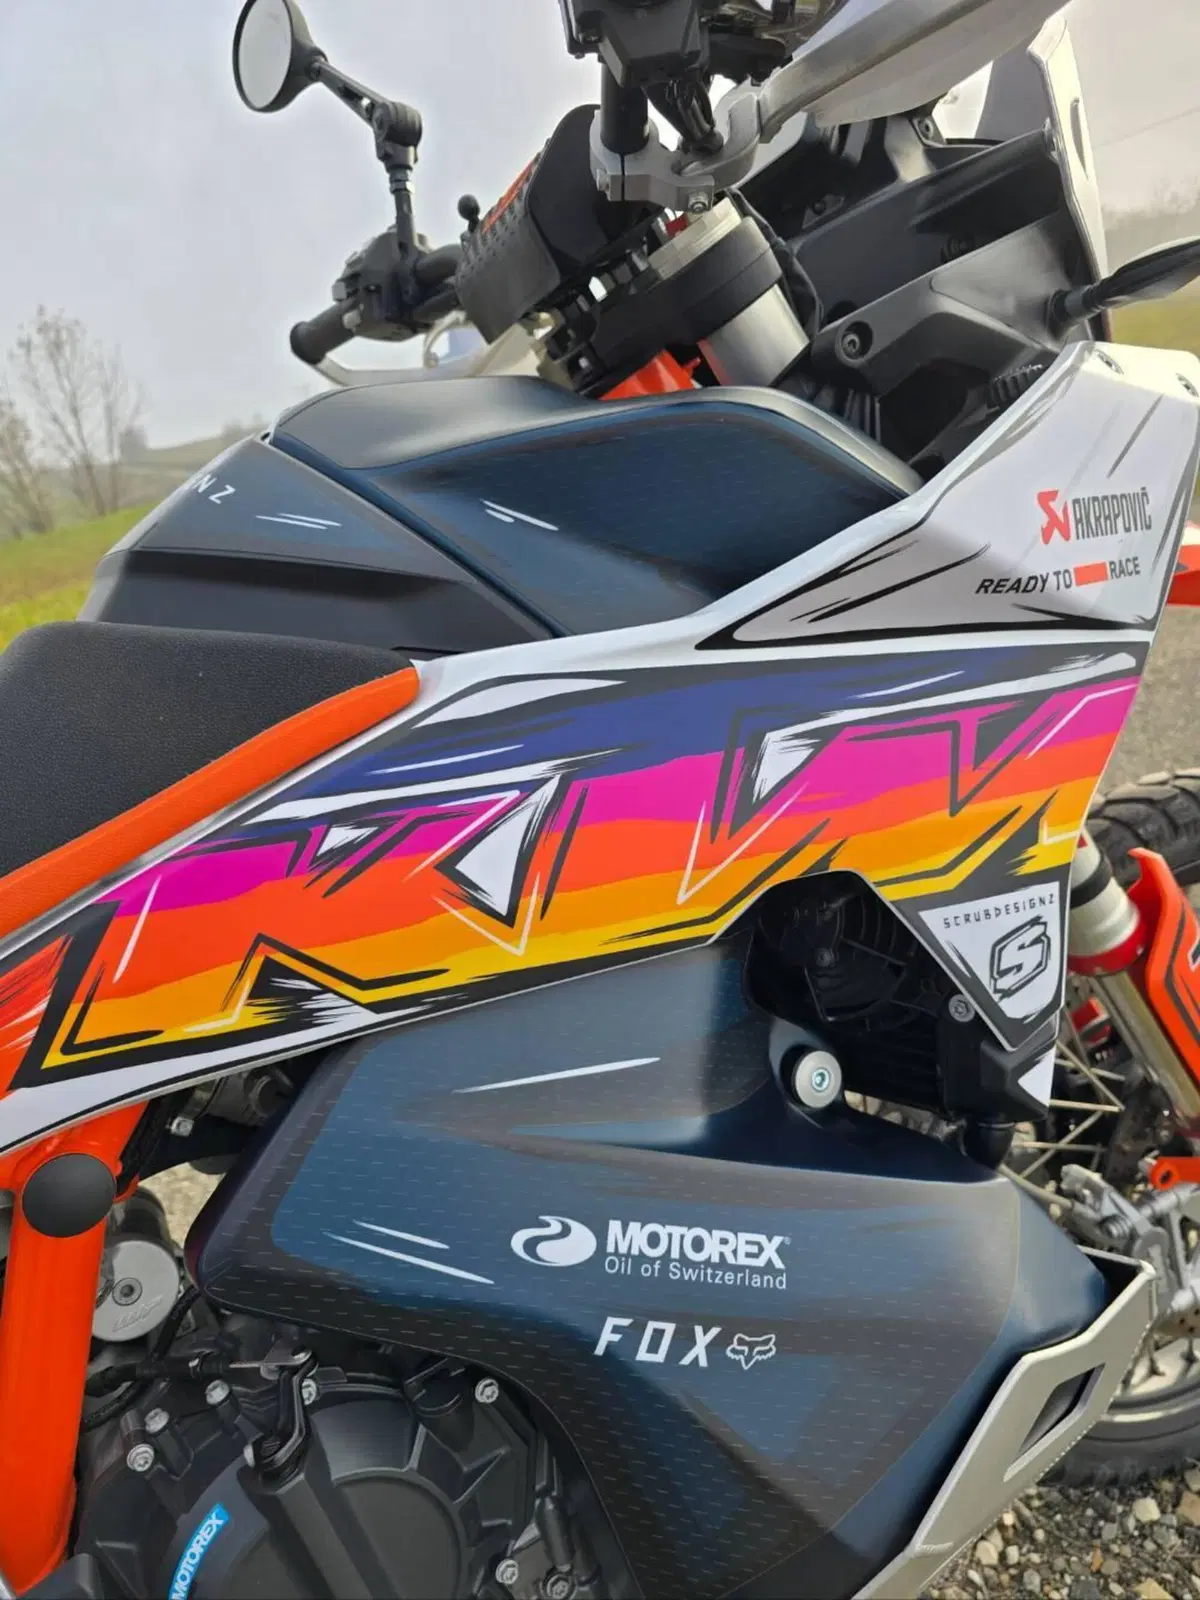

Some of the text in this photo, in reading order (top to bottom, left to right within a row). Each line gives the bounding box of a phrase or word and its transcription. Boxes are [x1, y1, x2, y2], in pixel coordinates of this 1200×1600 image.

[975, 556, 1141, 594] READY TO RACE
[943, 893, 1055, 929] SCRUBDESIGNZ
[606, 1219, 786, 1270] MOTOREX
[604, 1256, 787, 1290] Oil of Switzerland
[593, 1316, 723, 1368] FOX
[171, 1511, 224, 1600] MOTOREX
